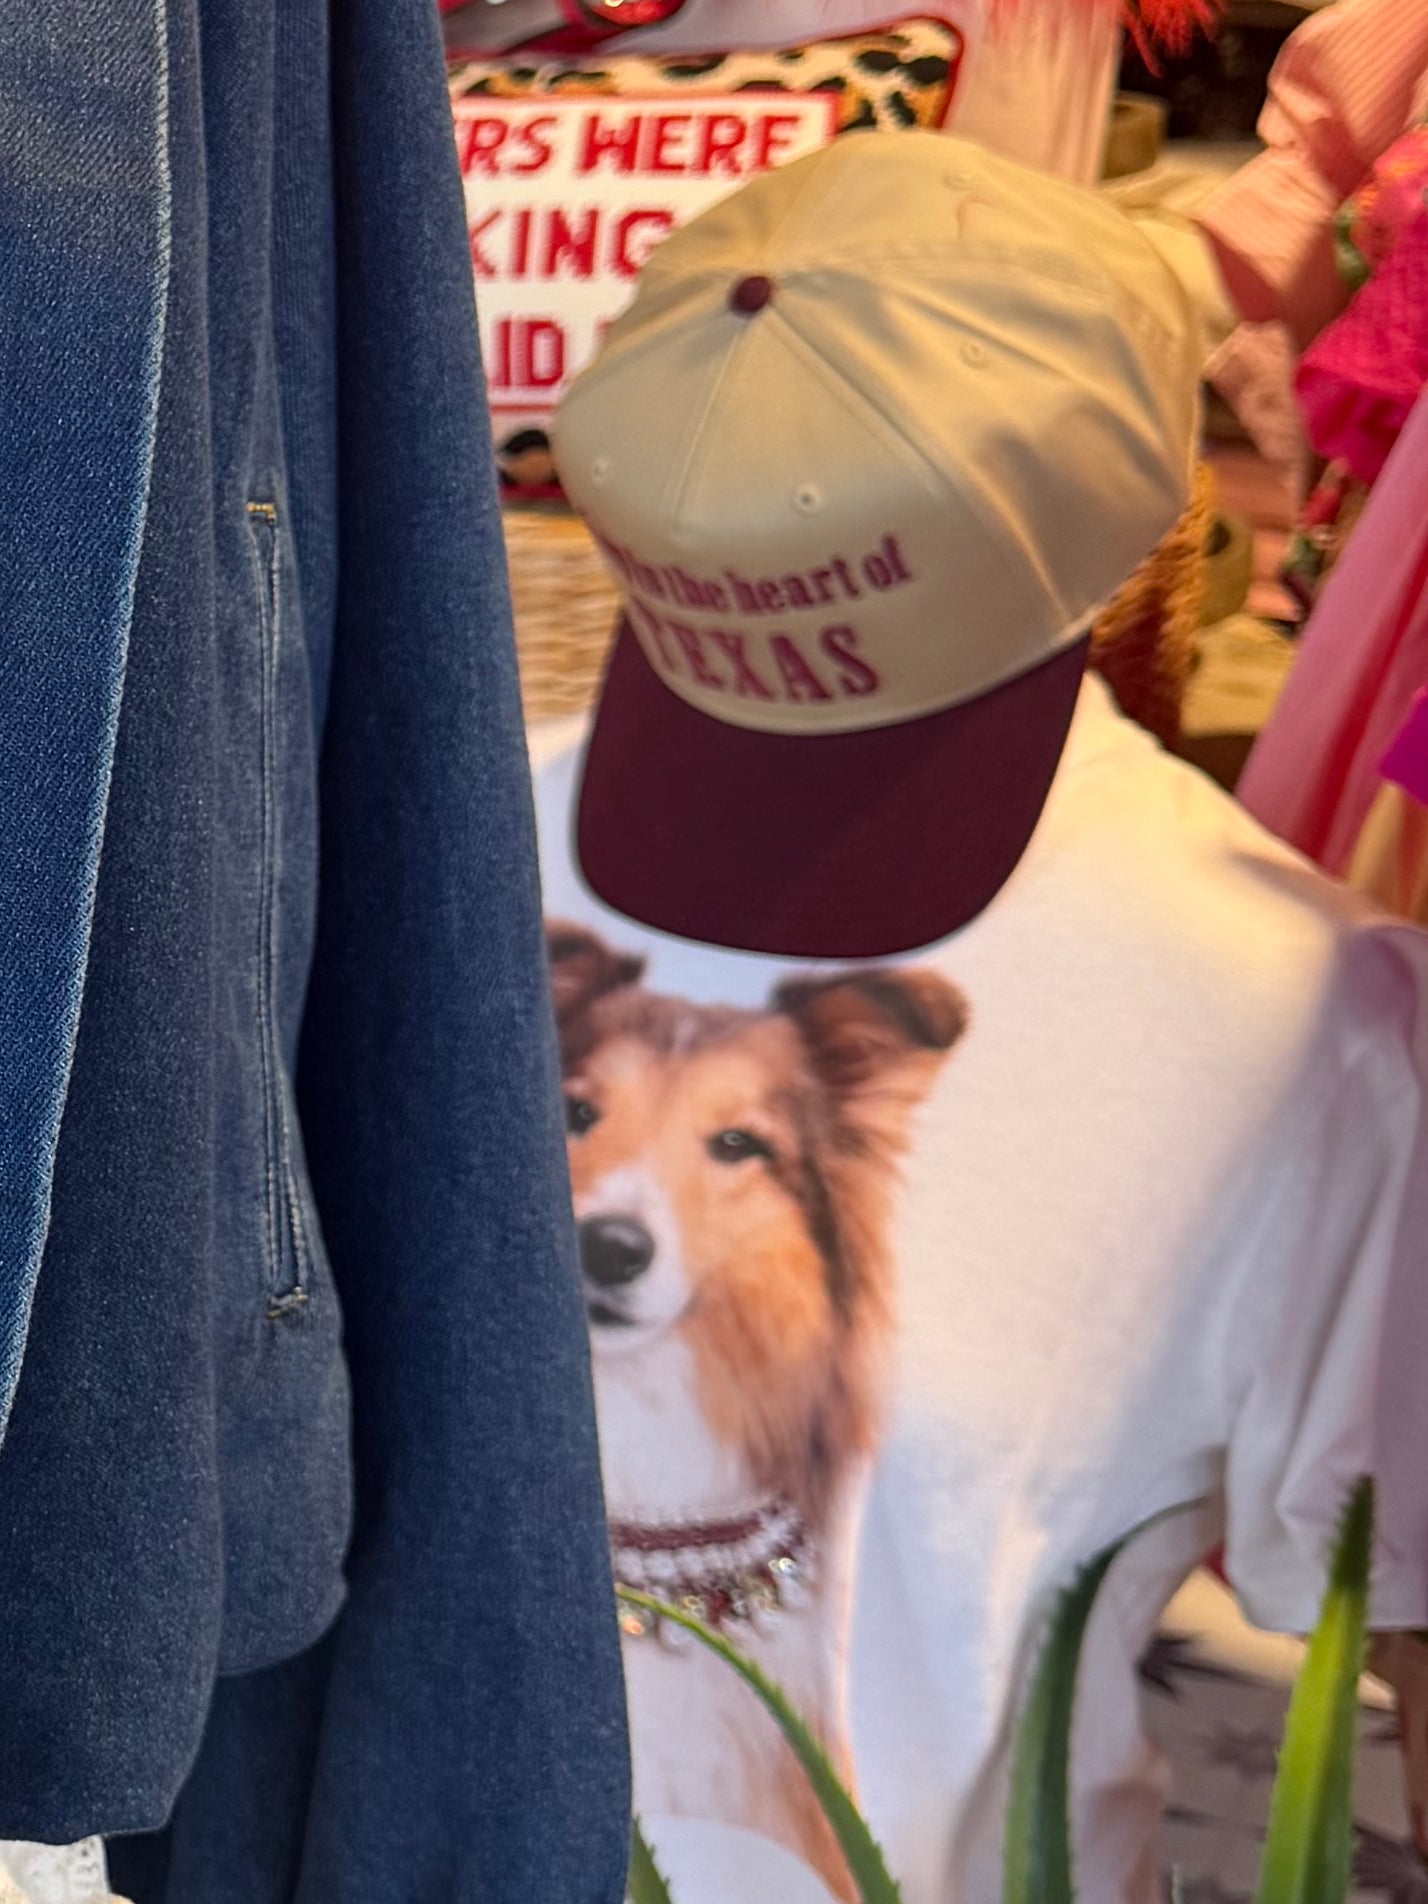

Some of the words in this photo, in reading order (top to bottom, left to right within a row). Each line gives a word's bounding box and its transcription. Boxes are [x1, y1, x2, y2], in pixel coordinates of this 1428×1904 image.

[455, 116, 556, 176] RS
[721, 556, 859, 616] heart
[861, 532, 912, 594] of
[632, 596, 879, 703] TEXAS
